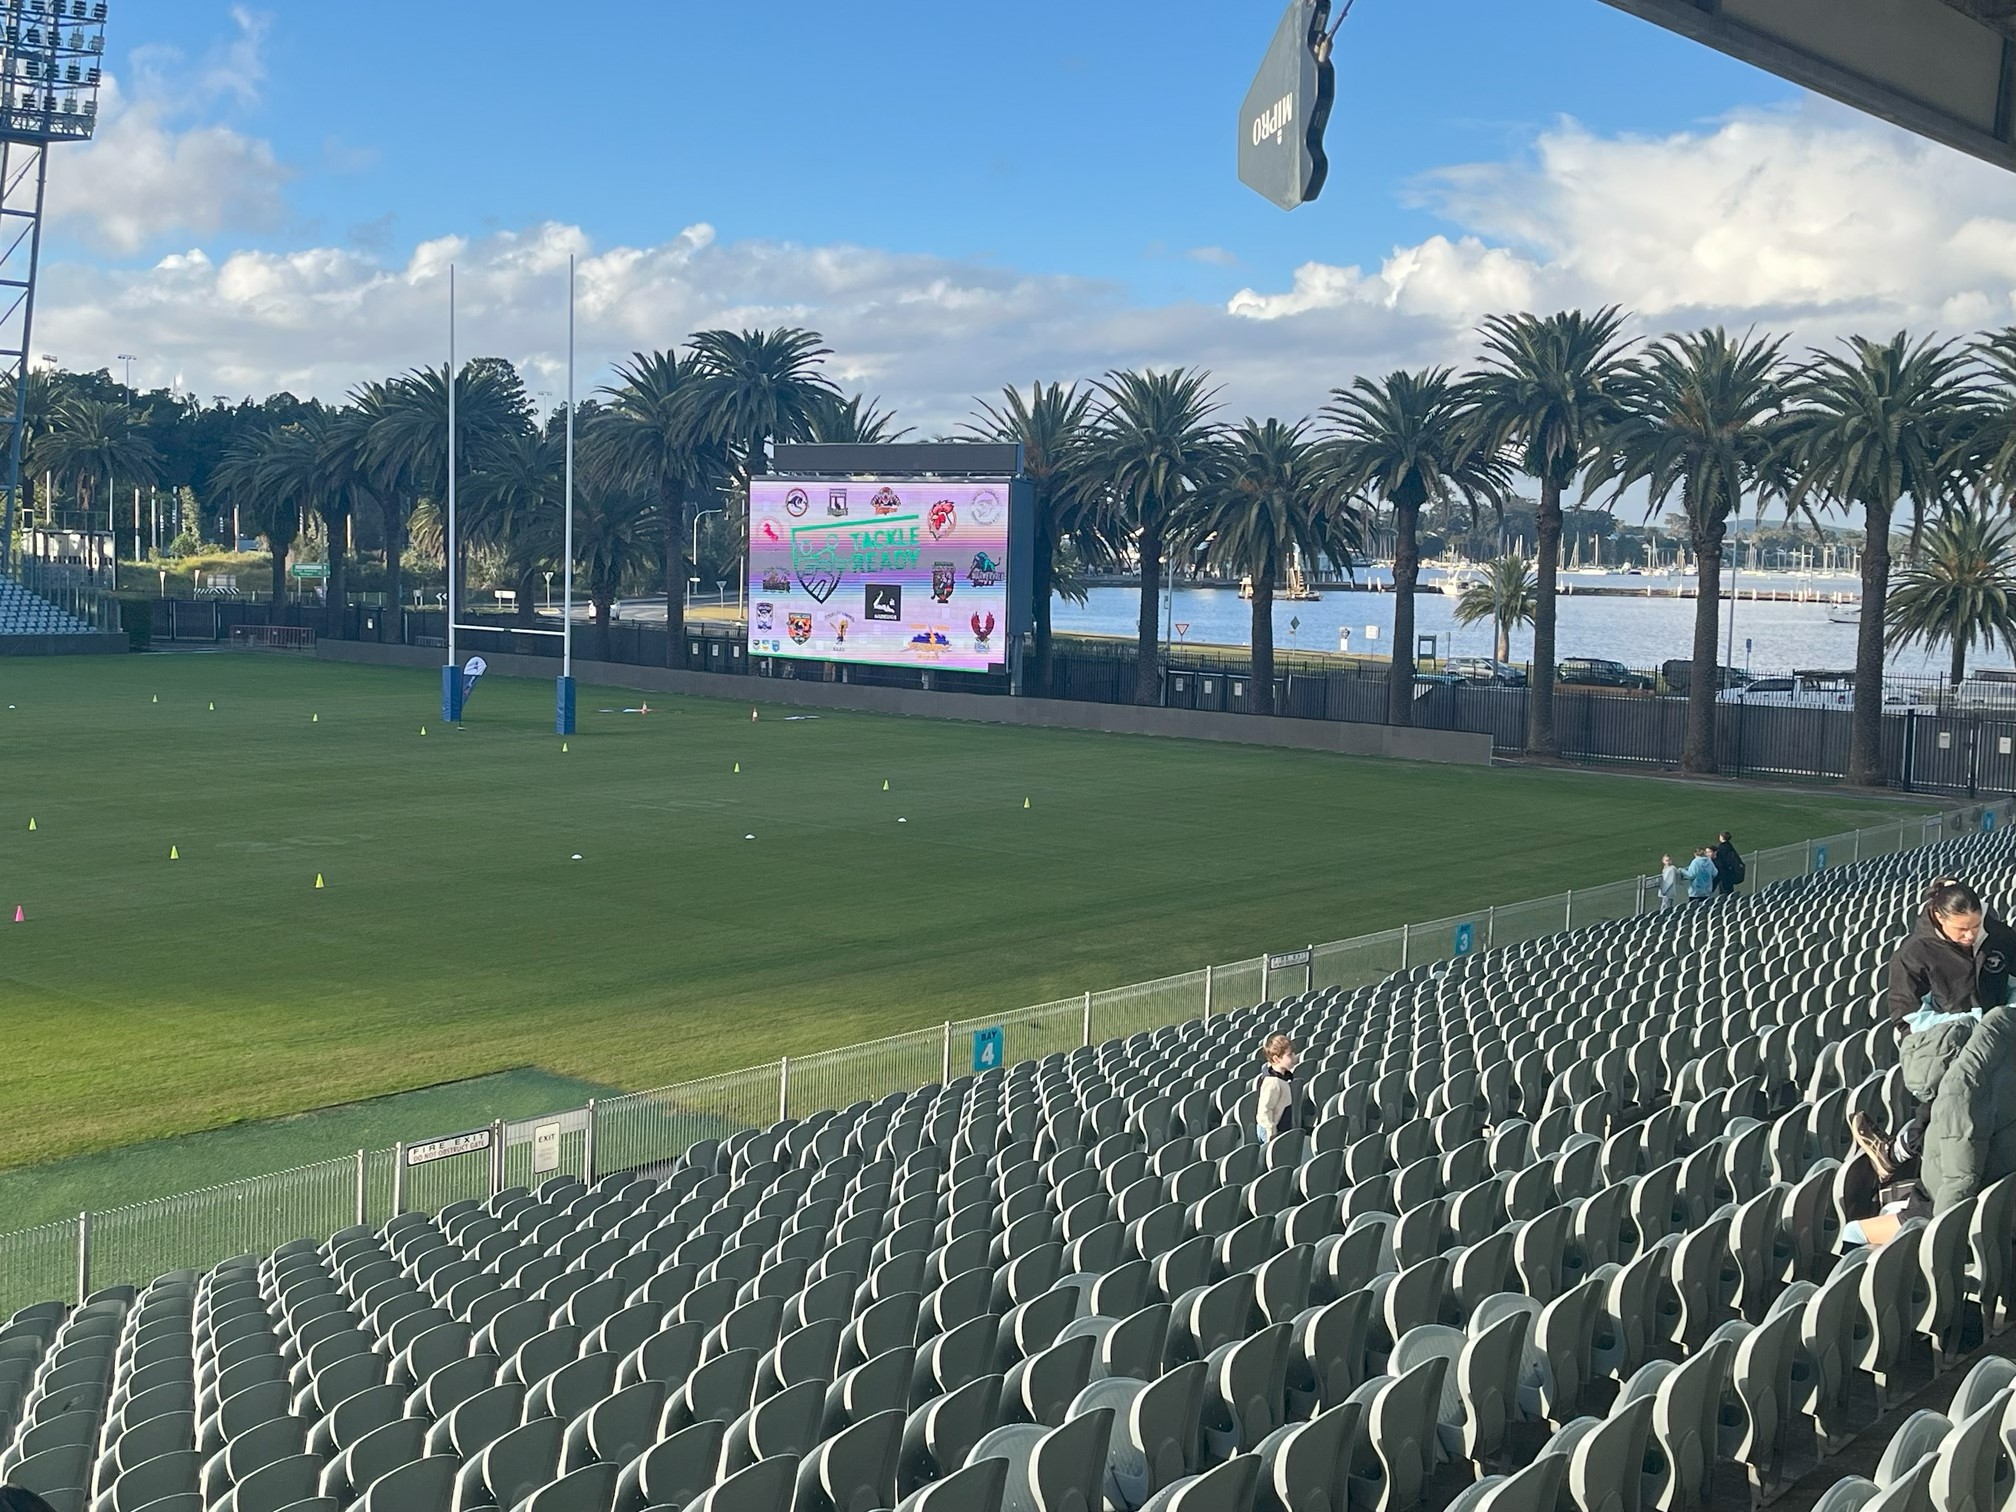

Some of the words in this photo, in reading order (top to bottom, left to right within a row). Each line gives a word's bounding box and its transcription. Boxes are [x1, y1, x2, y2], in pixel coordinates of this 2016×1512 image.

[1253, 92, 1292, 146] MIPRO
[849, 527, 920, 551] TACKLE
[851, 548, 920, 573] READY
[1460, 934, 1468, 951] 3
[981, 1030, 997, 1041] BAY
[982, 1042, 994, 1065] 4
[413, 1143, 445, 1155] FIRE
[455, 1134, 484, 1146] EXIT
[539, 1133, 555, 1143] EXIT
[414, 1154, 423, 1162] DO
[424, 1151, 437, 1160] NOT
[438, 1144, 469, 1157] OBSTRUCT
[470, 1140, 485, 1149] GATE
